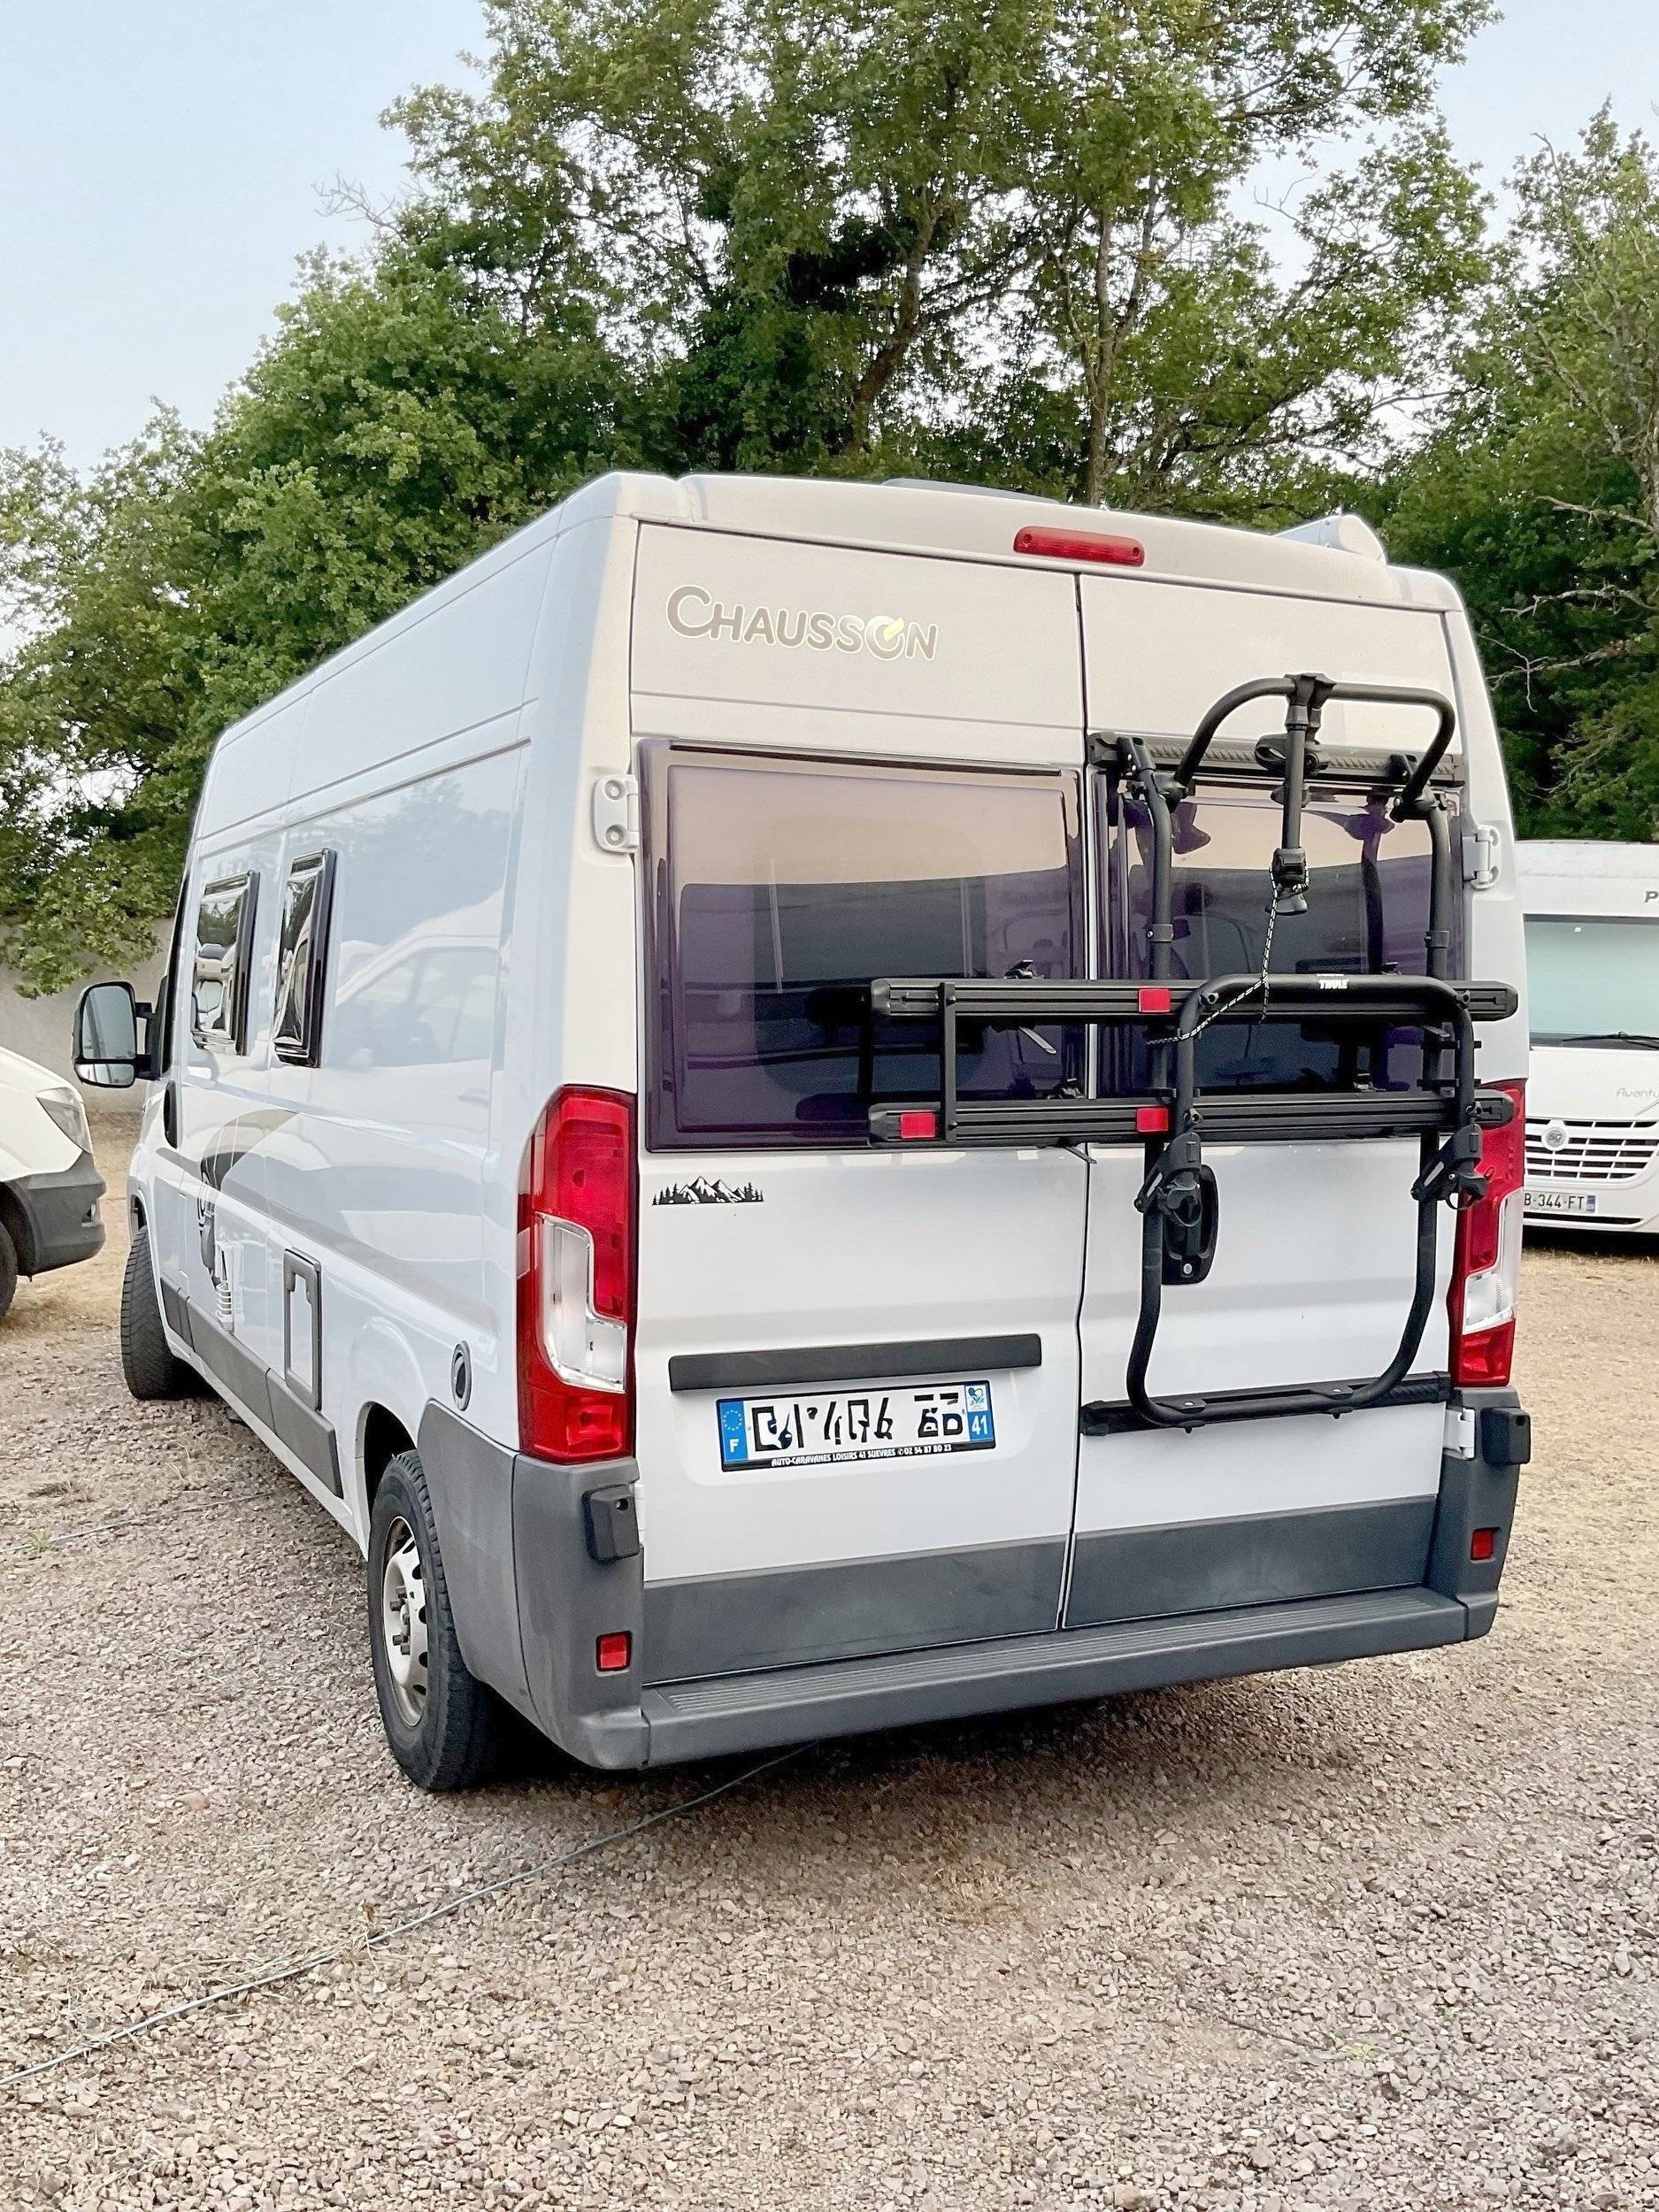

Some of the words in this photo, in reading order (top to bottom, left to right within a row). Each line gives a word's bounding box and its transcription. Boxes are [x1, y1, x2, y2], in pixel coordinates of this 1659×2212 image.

[666, 585, 939, 661] CHAUSSON
[1318, 979, 1348, 989] THULE
[972, 1415, 988, 1435] 41
[730, 1439, 740, 1453] F
[772, 1454, 831, 1467] AUTO-CARAVANES
[833, 1451, 857, 1461] LOISIRS
